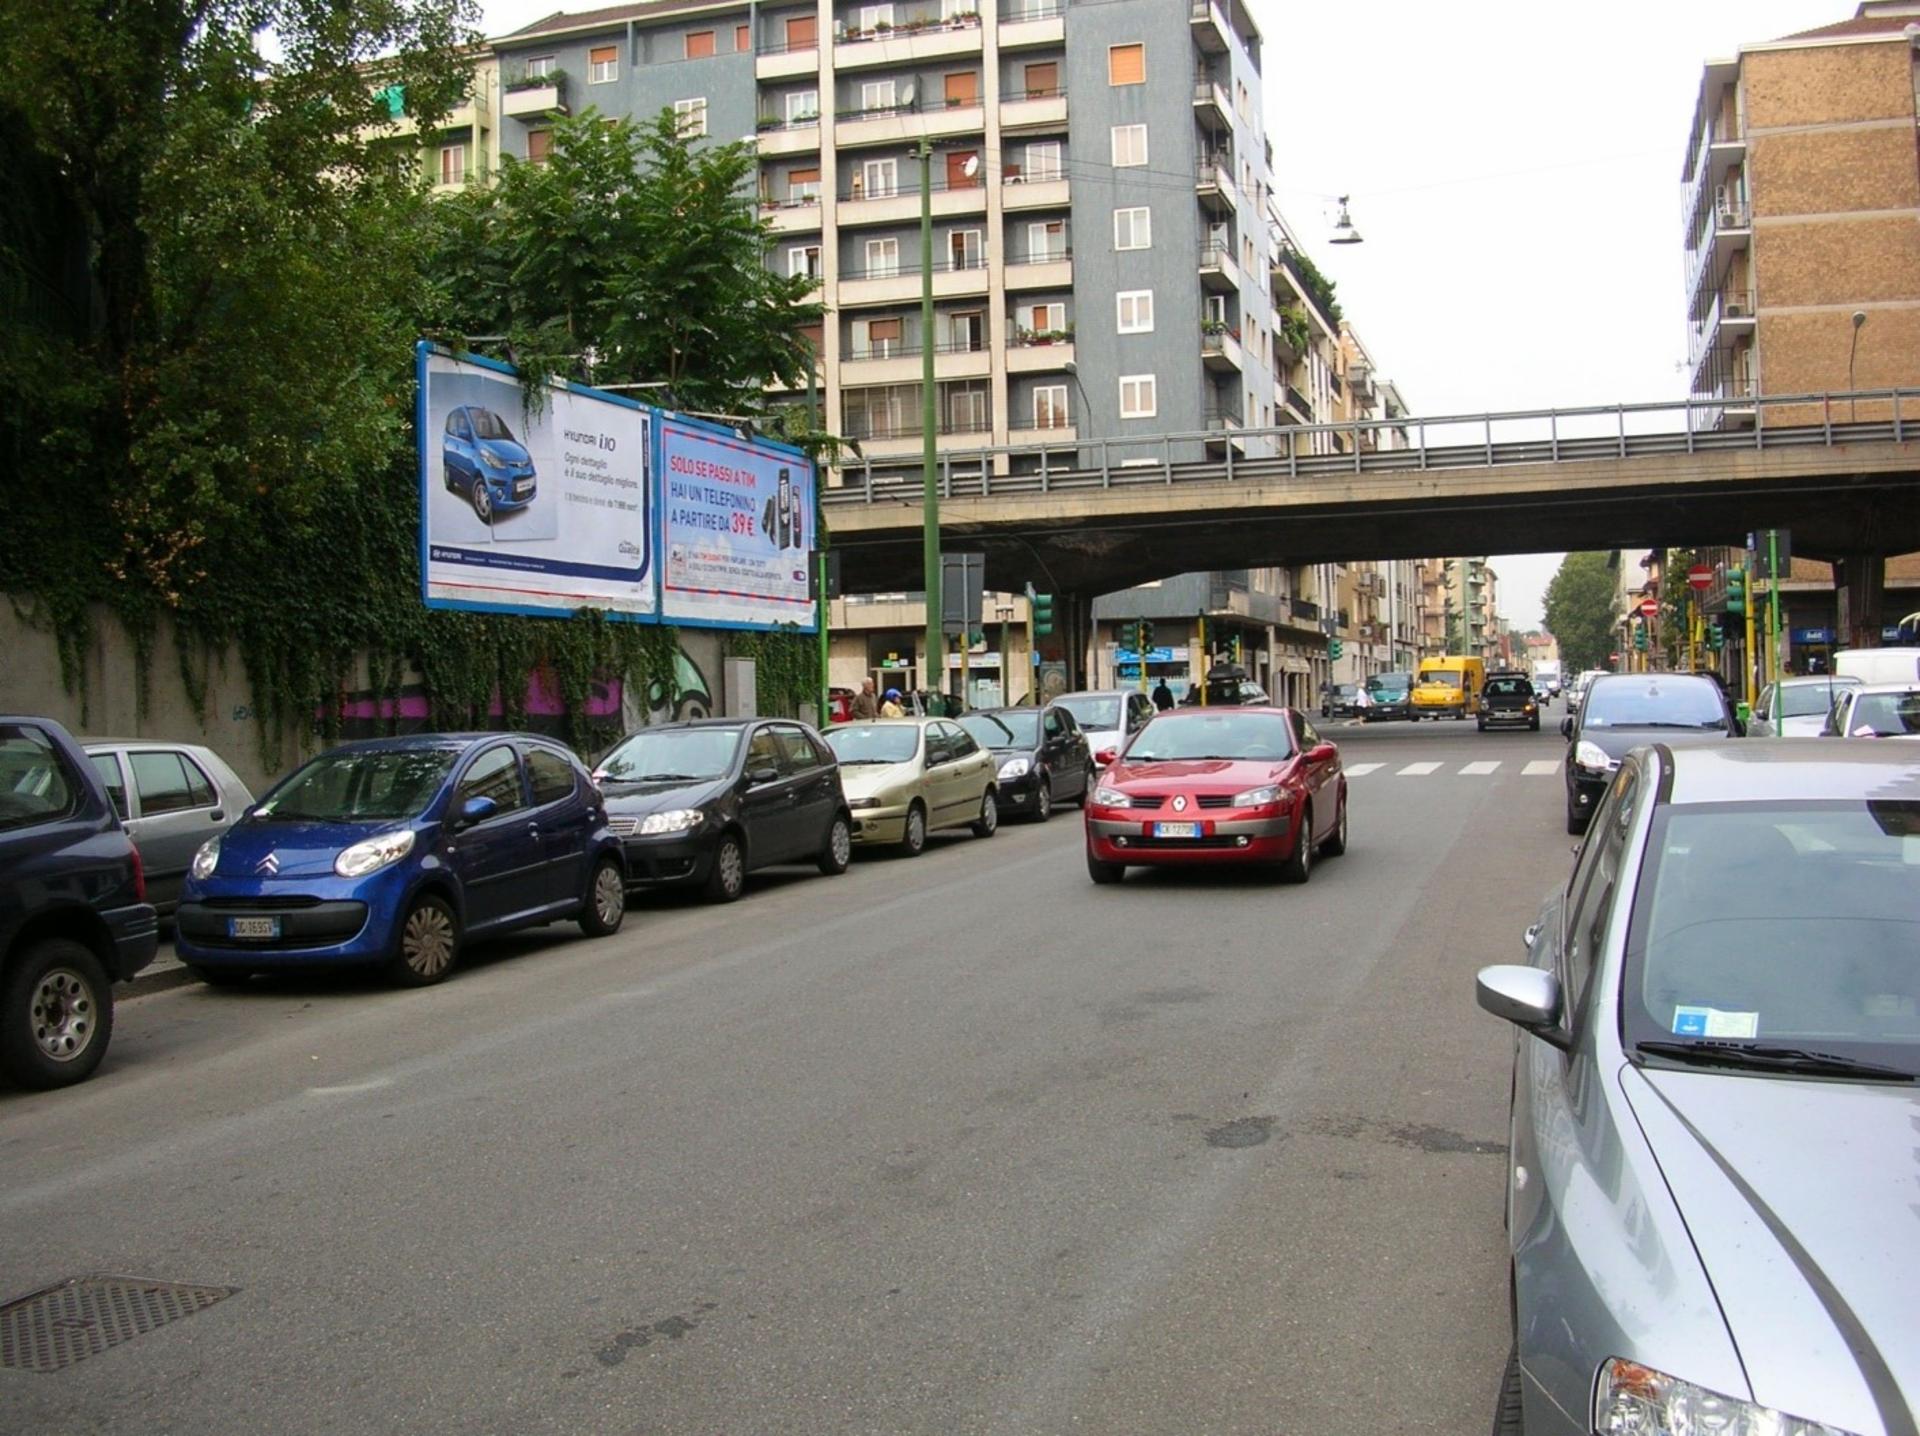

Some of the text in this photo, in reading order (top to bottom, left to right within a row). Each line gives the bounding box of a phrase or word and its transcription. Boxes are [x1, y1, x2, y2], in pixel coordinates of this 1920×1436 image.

[564, 451, 607, 471] Ogni dettaglio
[671, 455, 756, 488] SOLO SE PASSI A TIM
[576, 470, 587, 480] suo
[588, 471, 614, 486] dettaglio
[671, 482, 756, 512] HAI UN TELEFONINO
[671, 508, 755, 537] A PARTIRE DA 39 €
